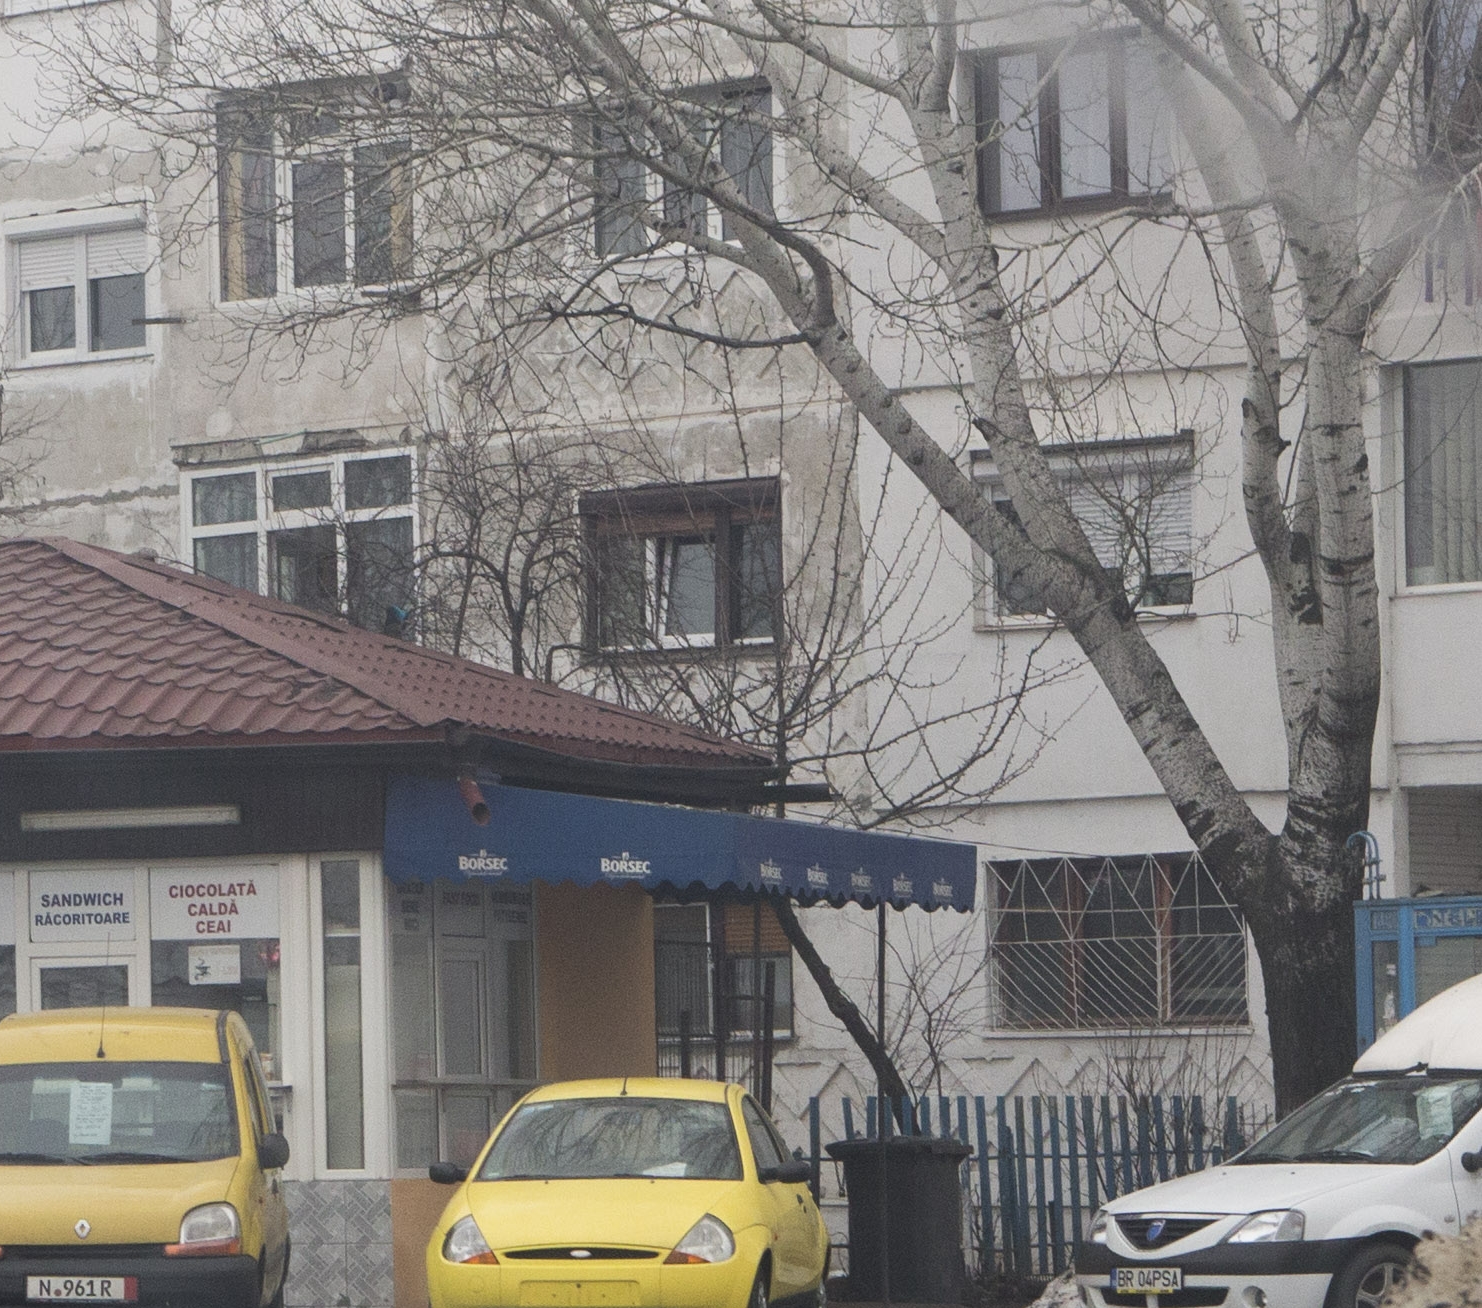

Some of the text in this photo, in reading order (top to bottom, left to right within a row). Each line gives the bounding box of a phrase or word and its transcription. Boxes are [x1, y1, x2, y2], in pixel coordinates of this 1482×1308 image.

[458, 856, 508, 870] BORSEC
[600, 857, 652, 874] BORSEC
[168, 879, 258, 899] CIOCOLATĂ
[40, 893, 125, 908] SANDWICH
[187, 899, 239, 917] CALDĂ
[34, 911, 131, 927] RĂCORITOARE
[195, 920, 232, 935] CEAI
[1118, 1270, 1134, 1288] BR
